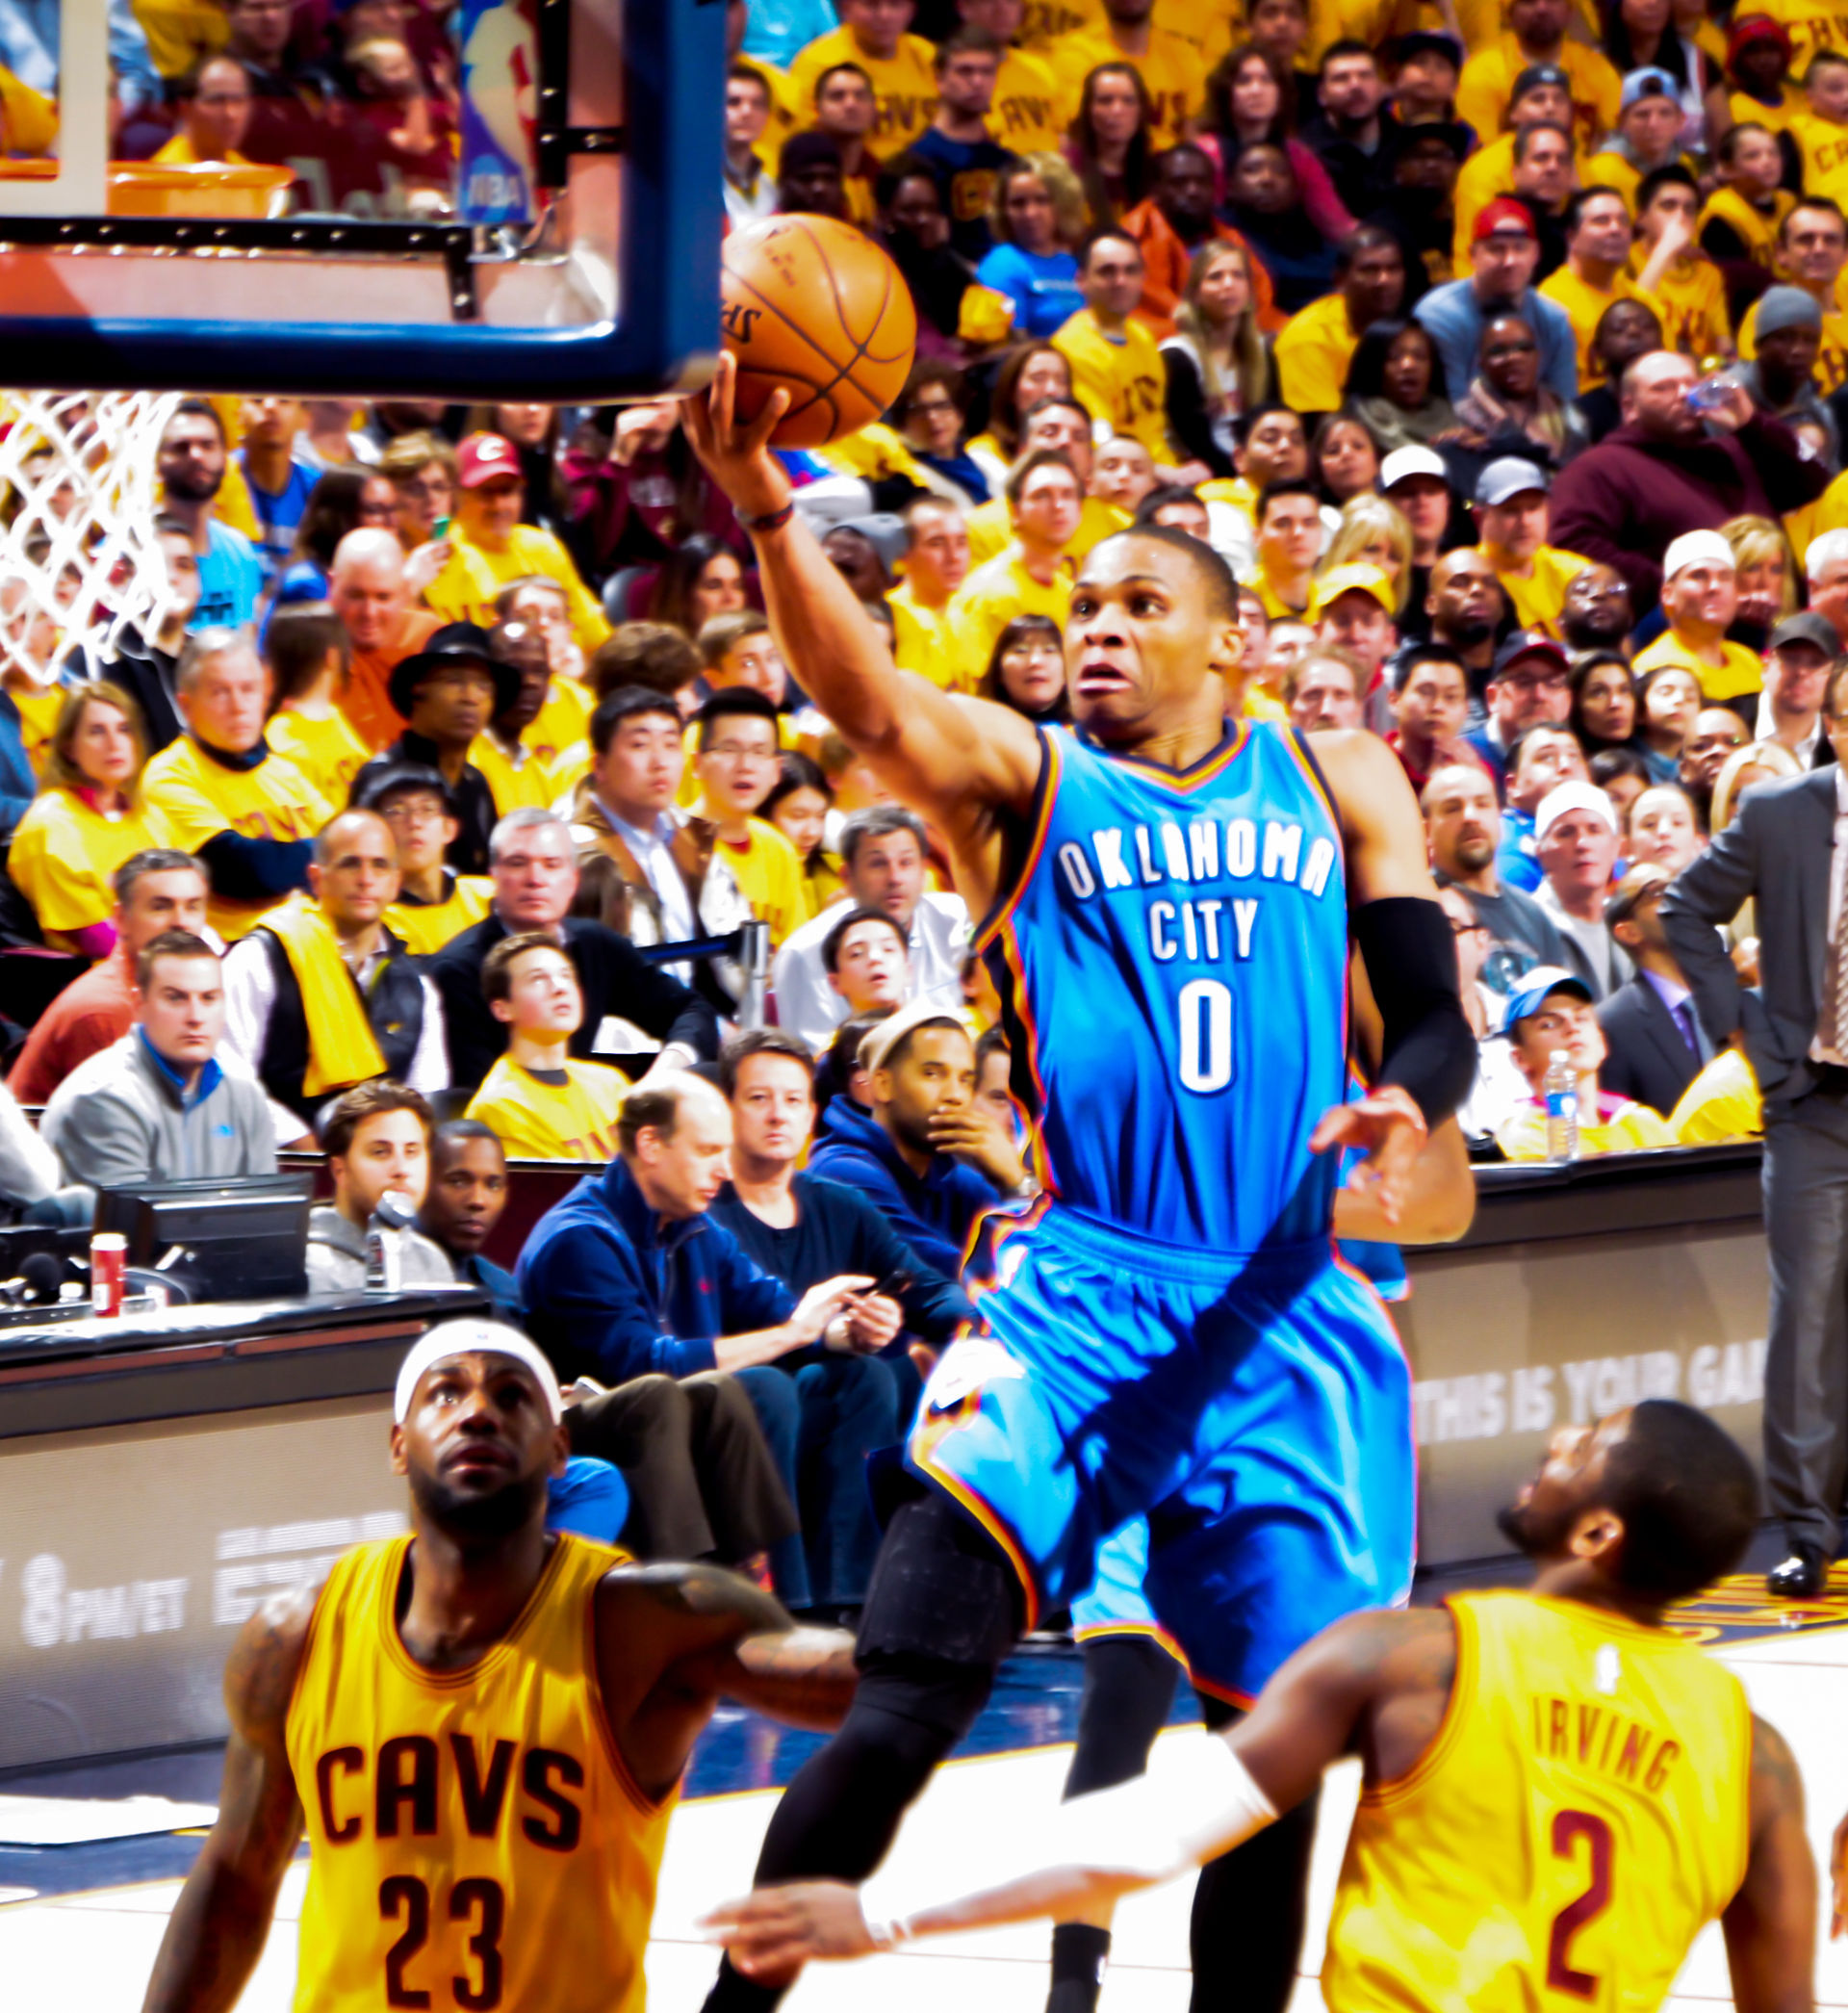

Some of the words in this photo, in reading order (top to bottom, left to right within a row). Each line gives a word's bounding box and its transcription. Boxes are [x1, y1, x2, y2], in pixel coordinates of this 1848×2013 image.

[469, 174, 524, 207] NBA
[1058, 817, 1336, 899] OKLAHOMA
[1149, 897, 1260, 962] CITY
[1178, 977, 1233, 1094] 0
[1415, 1371, 1506, 1444] THIS
[1511, 1364, 1556, 1432] IS
[1560, 1351, 1679, 1426] YOUR
[316, 1732, 585, 1853] CAVS
[1532, 1696, 1682, 1794] IRVING
[378, 1873, 505, 2013] 23
[1545, 1808, 1614, 2001] 2
